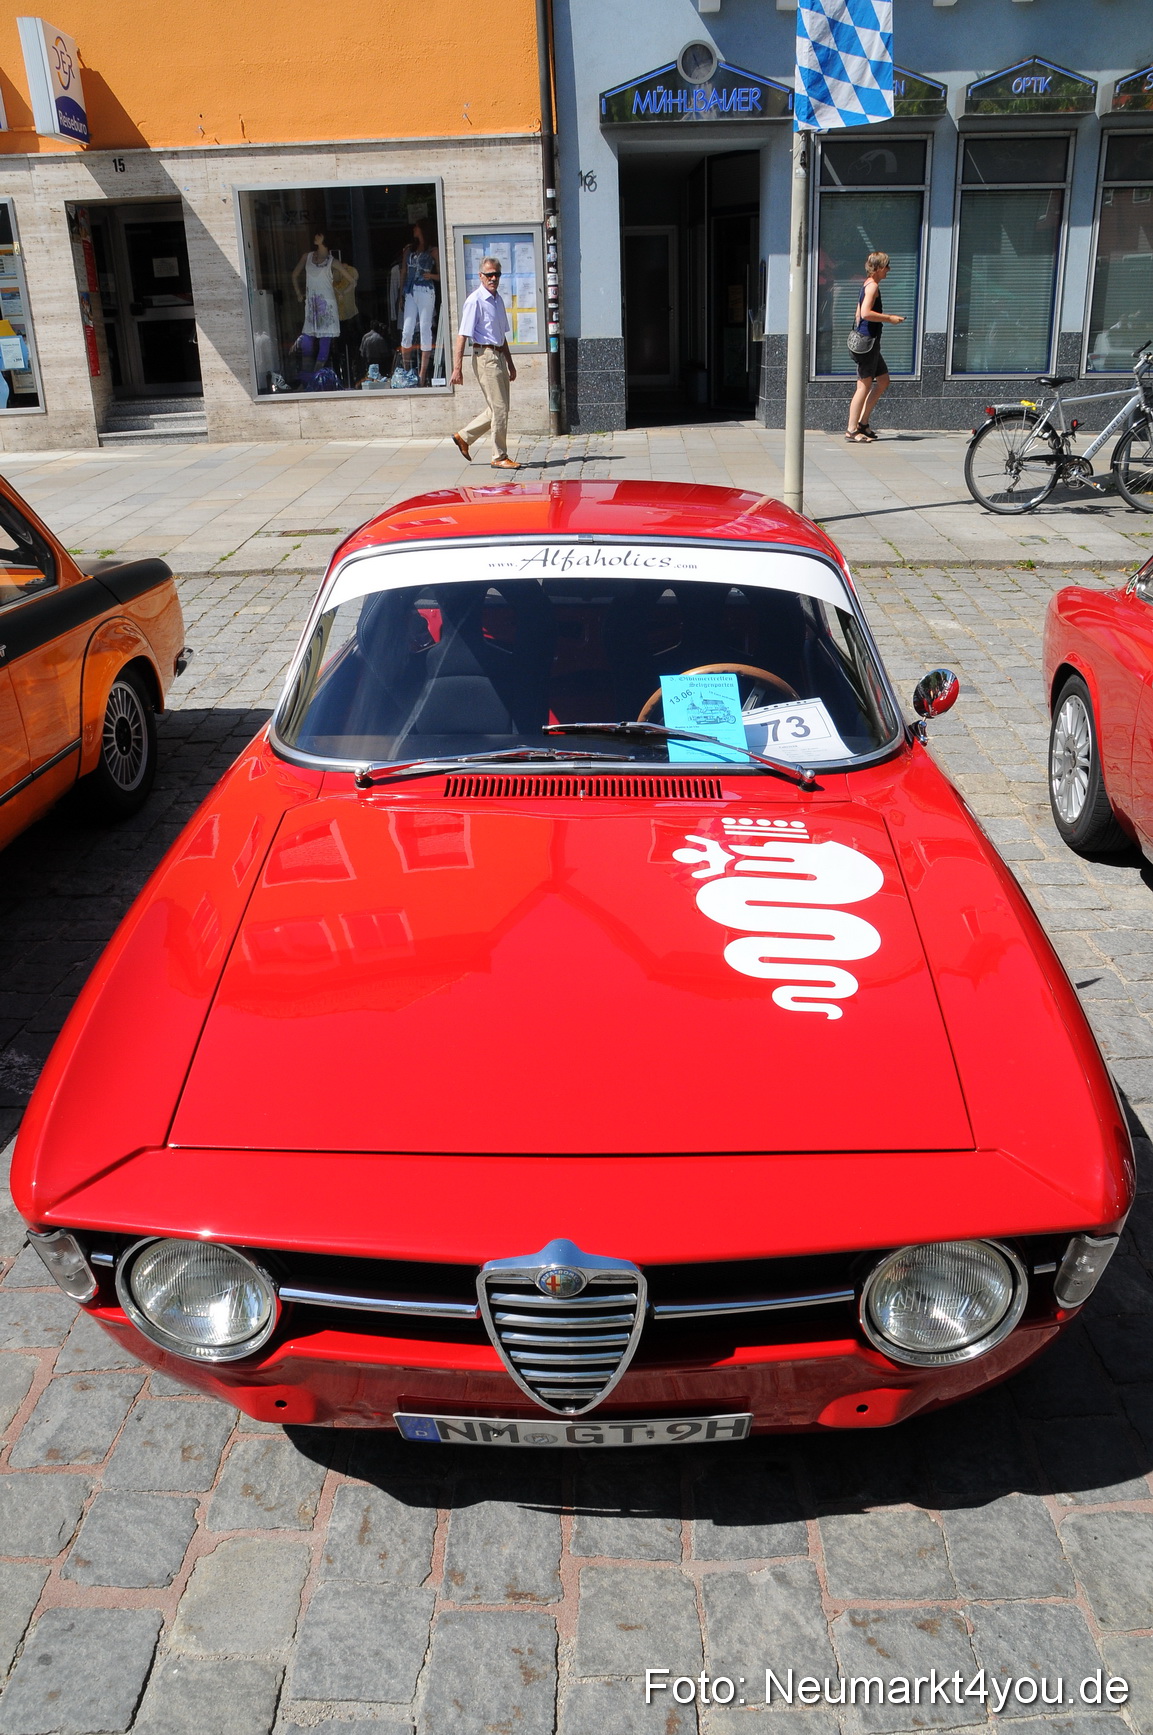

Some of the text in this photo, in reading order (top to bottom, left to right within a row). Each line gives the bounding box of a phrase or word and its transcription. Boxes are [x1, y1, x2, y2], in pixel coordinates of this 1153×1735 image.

[1011, 75, 1053, 95] OPTIK
[632, 85, 763, 115] MÜHLBAUER
[58, 110, 88, 136] Reisebüro
[112, 158, 126, 173] 15
[578, 169, 594, 187] 16
[760, 715, 811, 742] 73
[435, 1418, 748, 1445] NM GT 9H
